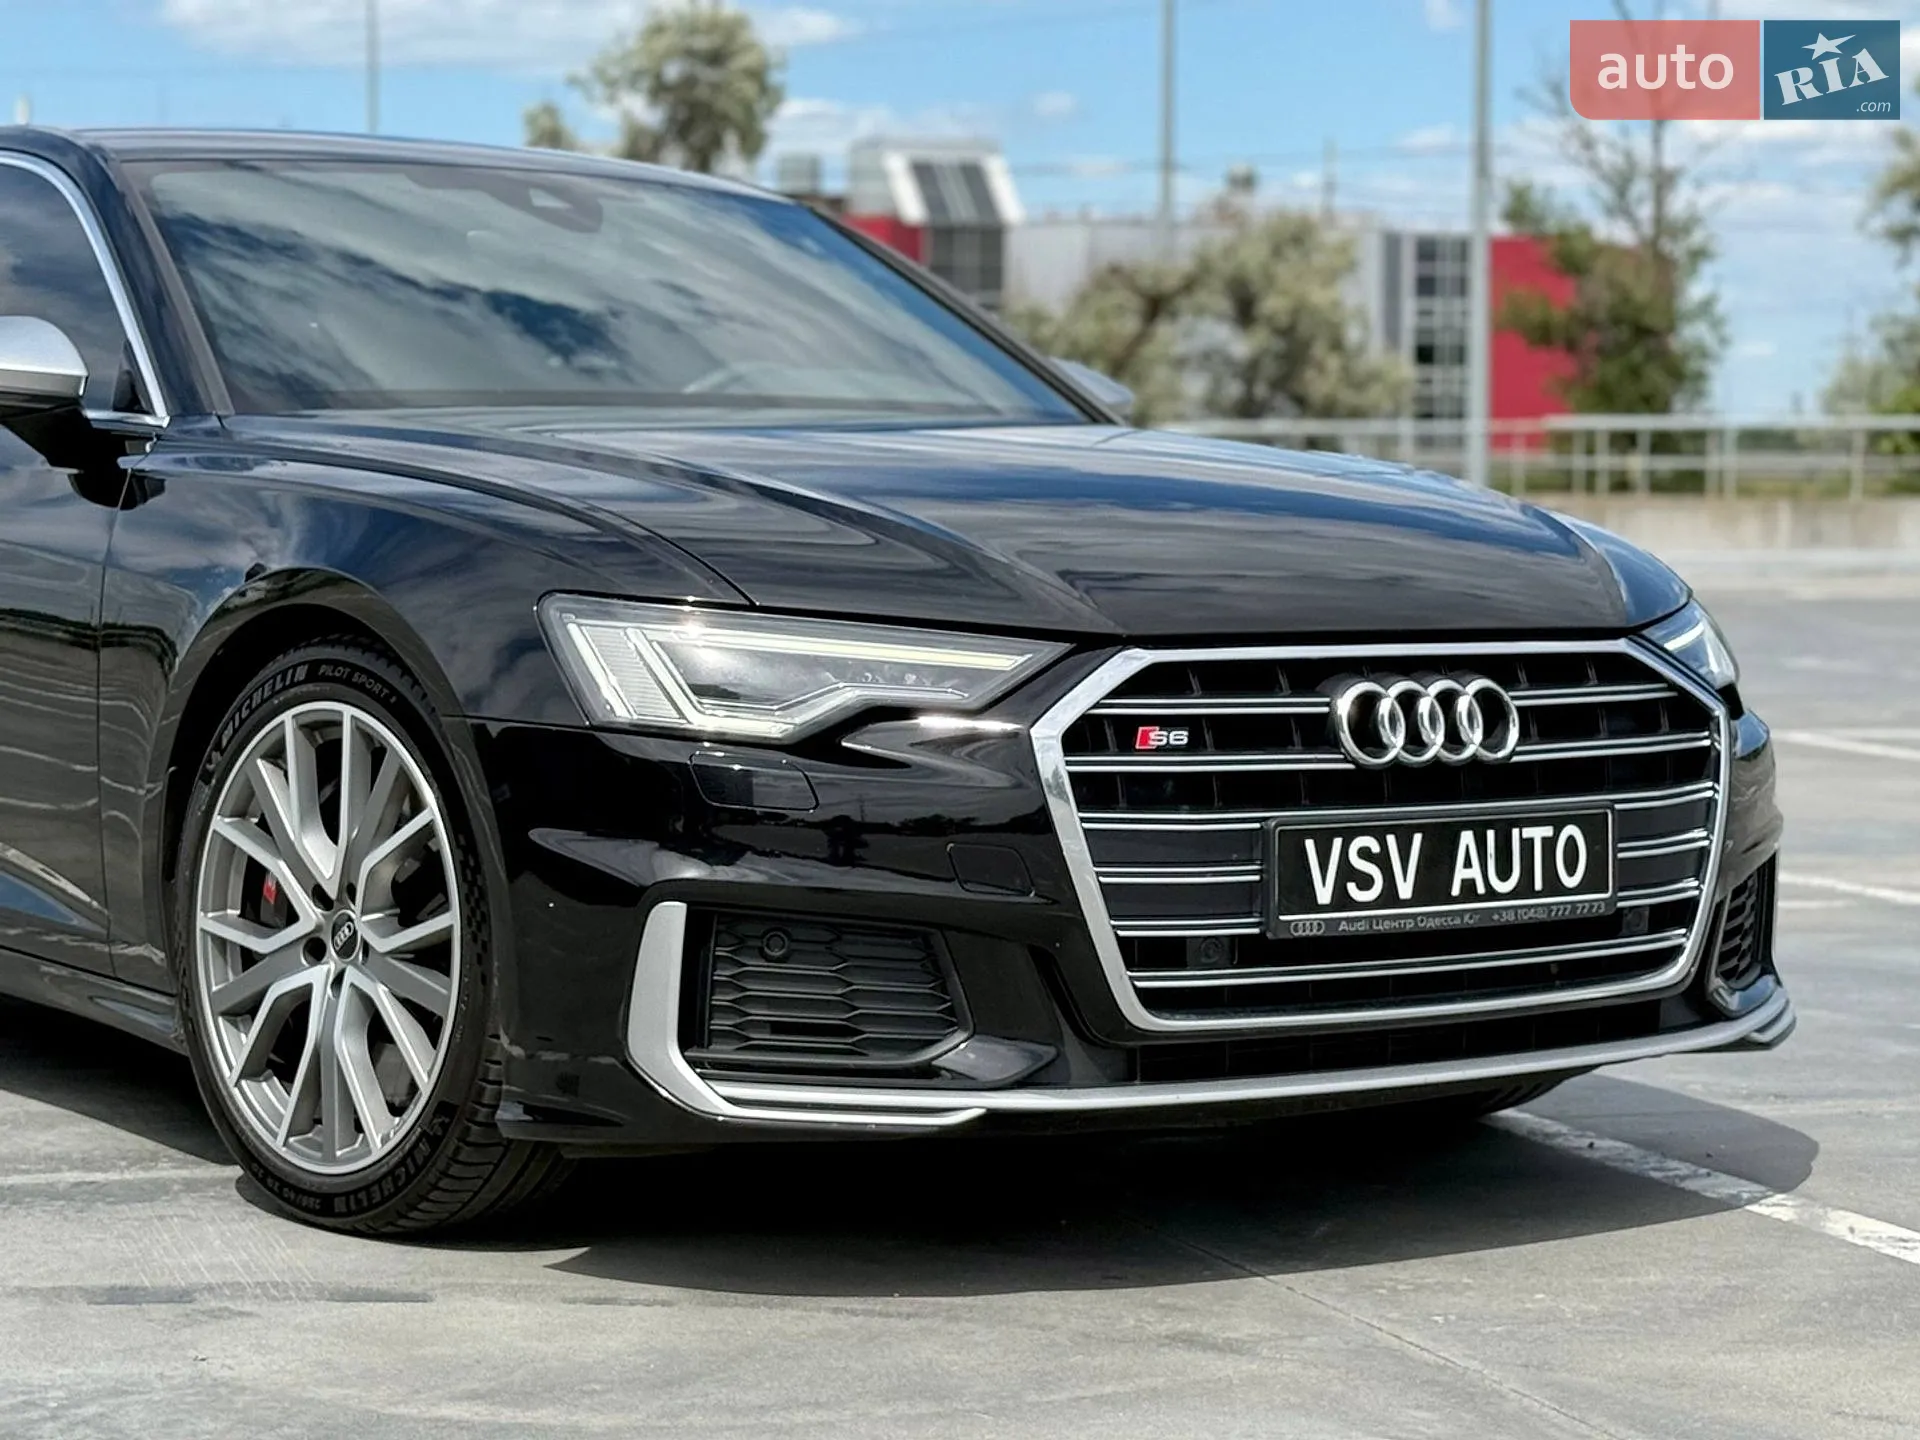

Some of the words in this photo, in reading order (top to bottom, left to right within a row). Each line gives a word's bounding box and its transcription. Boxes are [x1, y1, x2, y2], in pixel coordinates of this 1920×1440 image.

[221, 664, 309, 749] MICHELIN
[318, 664, 351, 679] PILOT
[352, 671, 390, 698] SPORT
[1148, 730, 1189, 746] S6
[1304, 832, 1423, 906] VSV
[1450, 824, 1588, 897] AUTO
[1338, 919, 1369, 932] Audi
[1372, 917, 1414, 932] Центр
[1417, 914, 1461, 930] Одесса
[334, 1138, 432, 1213] MICHELIN
